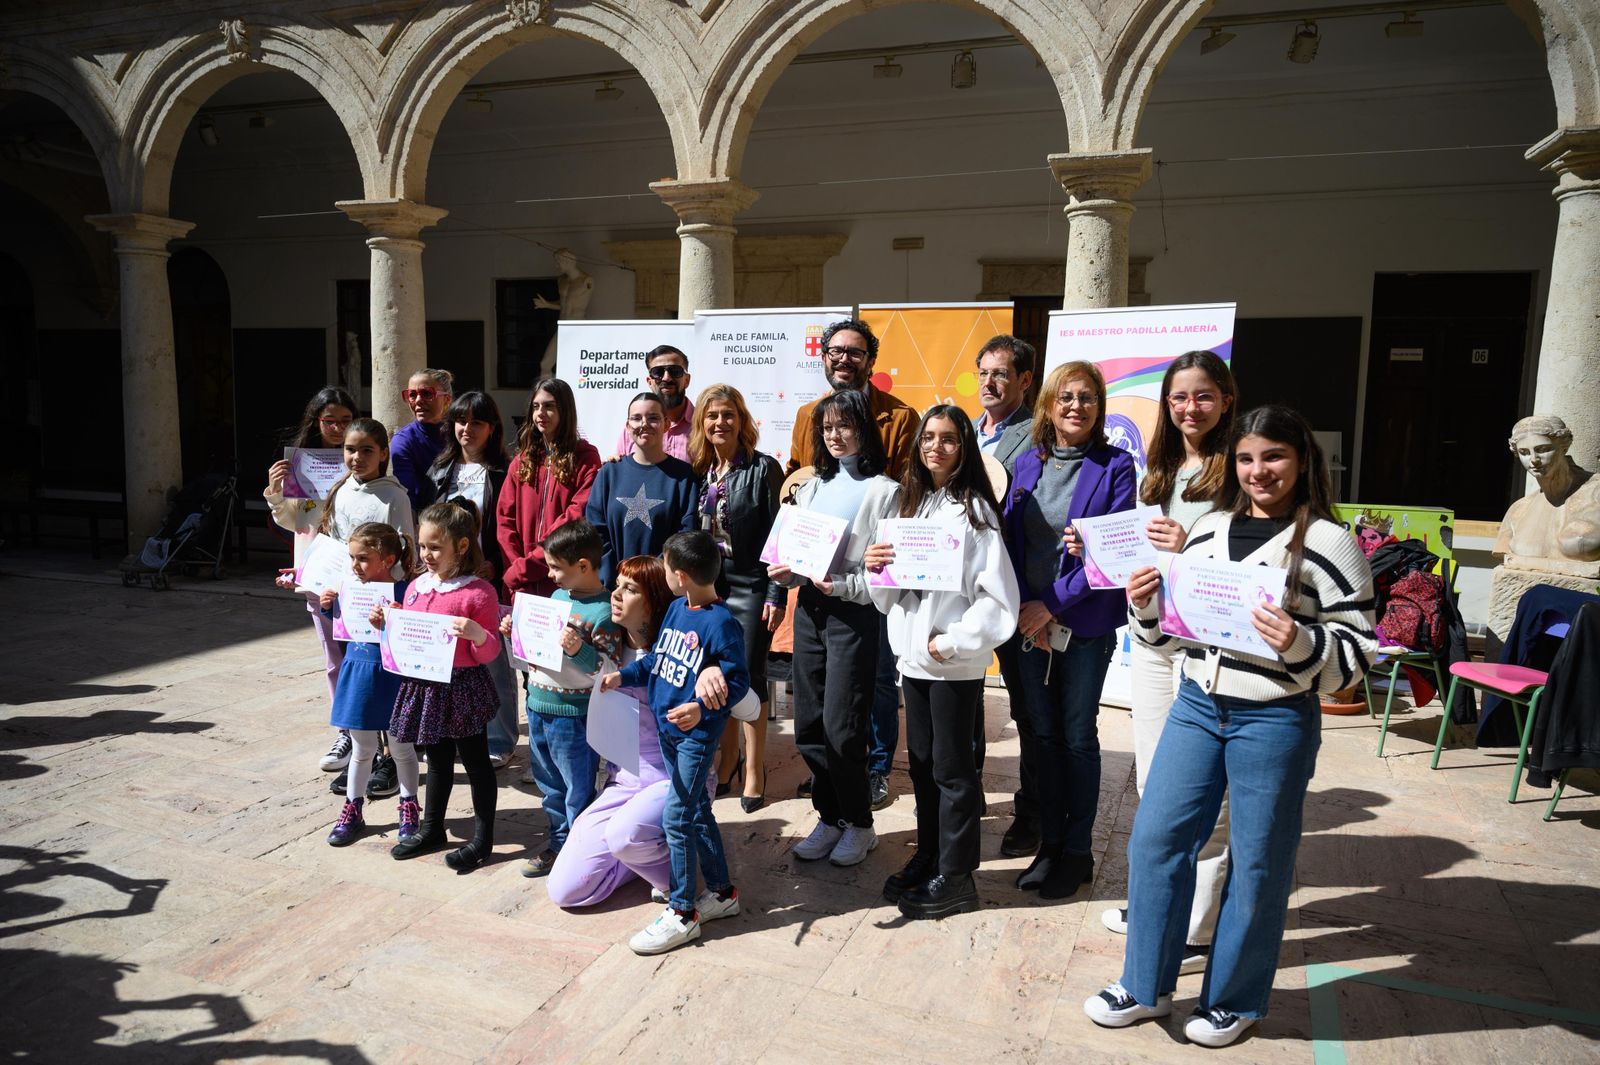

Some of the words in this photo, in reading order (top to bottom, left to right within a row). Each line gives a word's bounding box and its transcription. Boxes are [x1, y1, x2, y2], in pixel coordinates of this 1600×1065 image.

[1060, 329, 1074, 337] IES
[1077, 327, 1123, 337] MAESTRO
[1126, 326, 1167, 335] PADILLA
[1171, 324, 1218, 334] ALMERÍA
[710, 331, 734, 341] ÁREA
[736, 332, 748, 341] DE
[751, 332, 789, 342] FAMILIA,
[724, 344, 773, 354] INCLUSIÓN
[723, 357, 729, 365] E
[731, 356, 777, 365] IGUALDAD
[1474, 351, 1486, 362] 06
[580, 363, 629, 377] Igualdad
[578, 378, 639, 390] Diversidad
[1203, 581, 1239, 592] CONCURSO
[1193, 587, 1241, 601] INTERCENTROS
[651, 653, 688, 688] 1983
